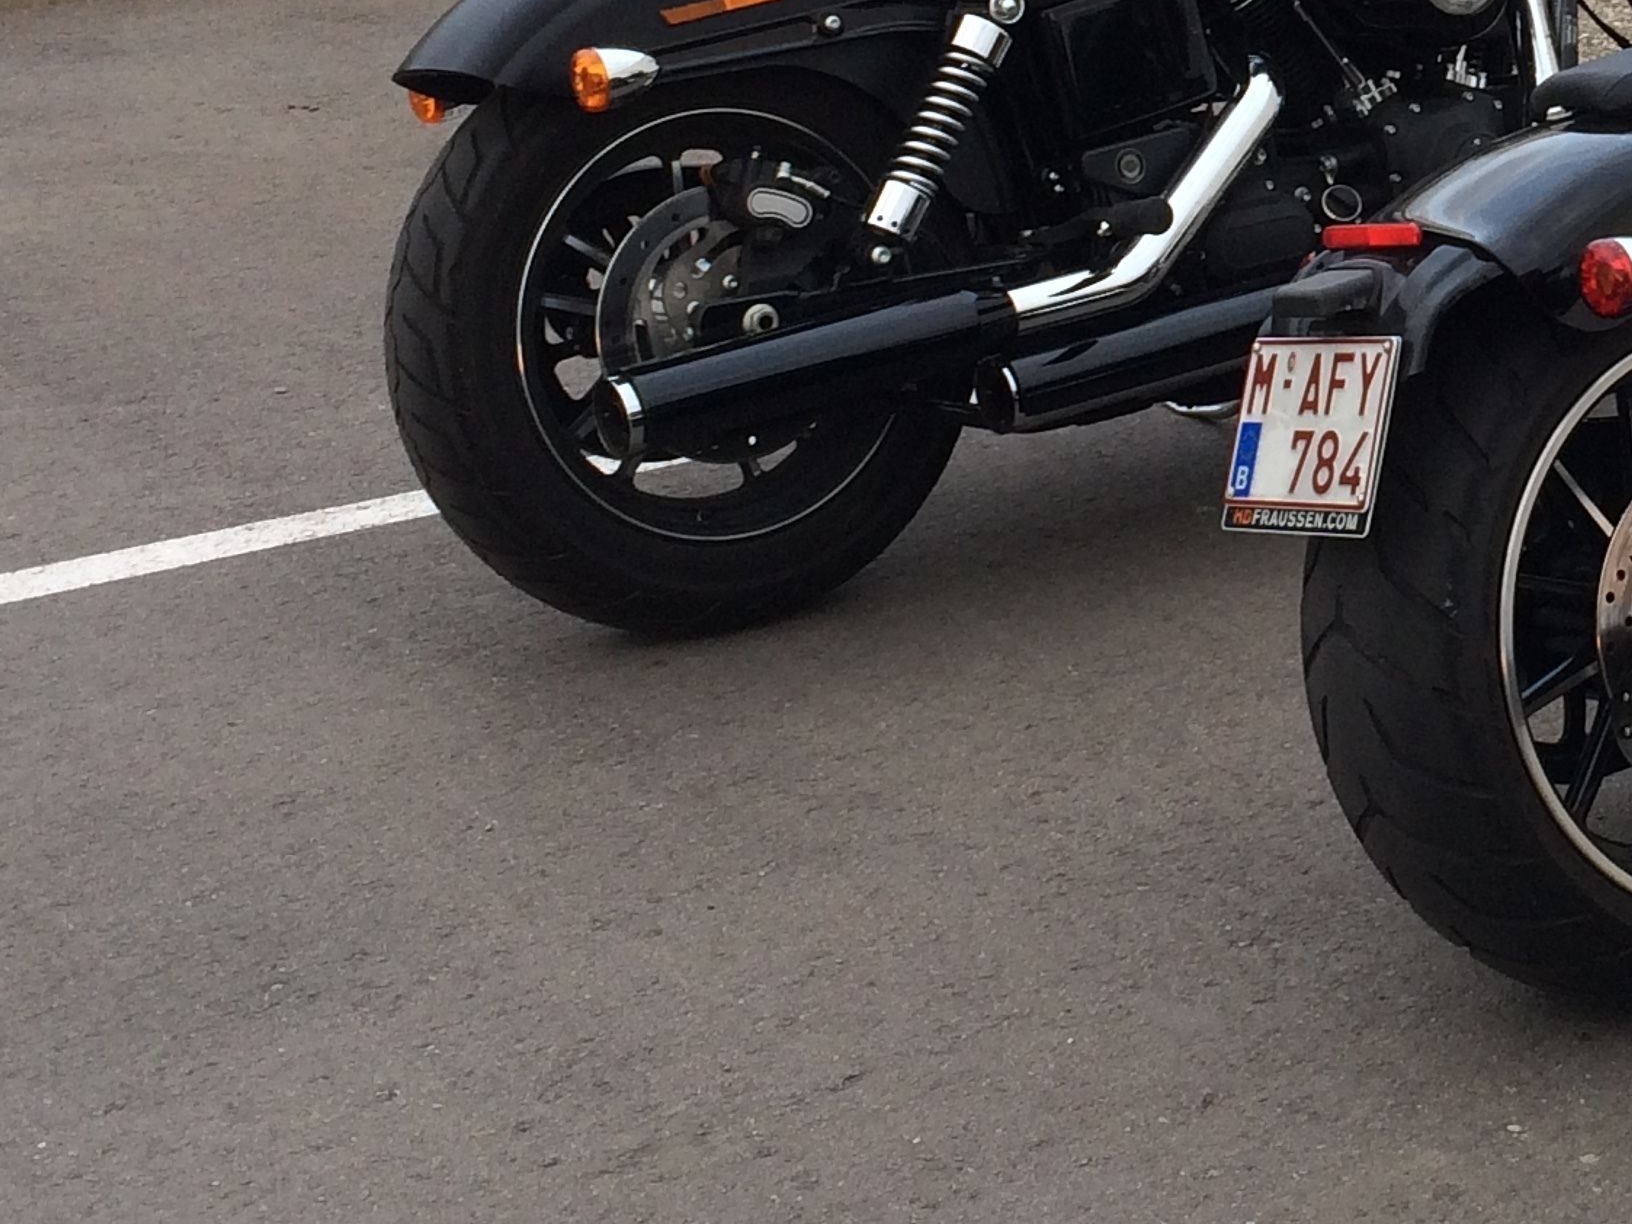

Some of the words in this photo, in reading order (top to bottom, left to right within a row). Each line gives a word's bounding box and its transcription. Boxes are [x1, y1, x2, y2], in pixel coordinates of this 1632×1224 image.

[1288, 429, 1369, 496] 784
[1235, 465, 1248, 490] B
[1232, 507, 1359, 531] HDFRAUSSEN.COM
